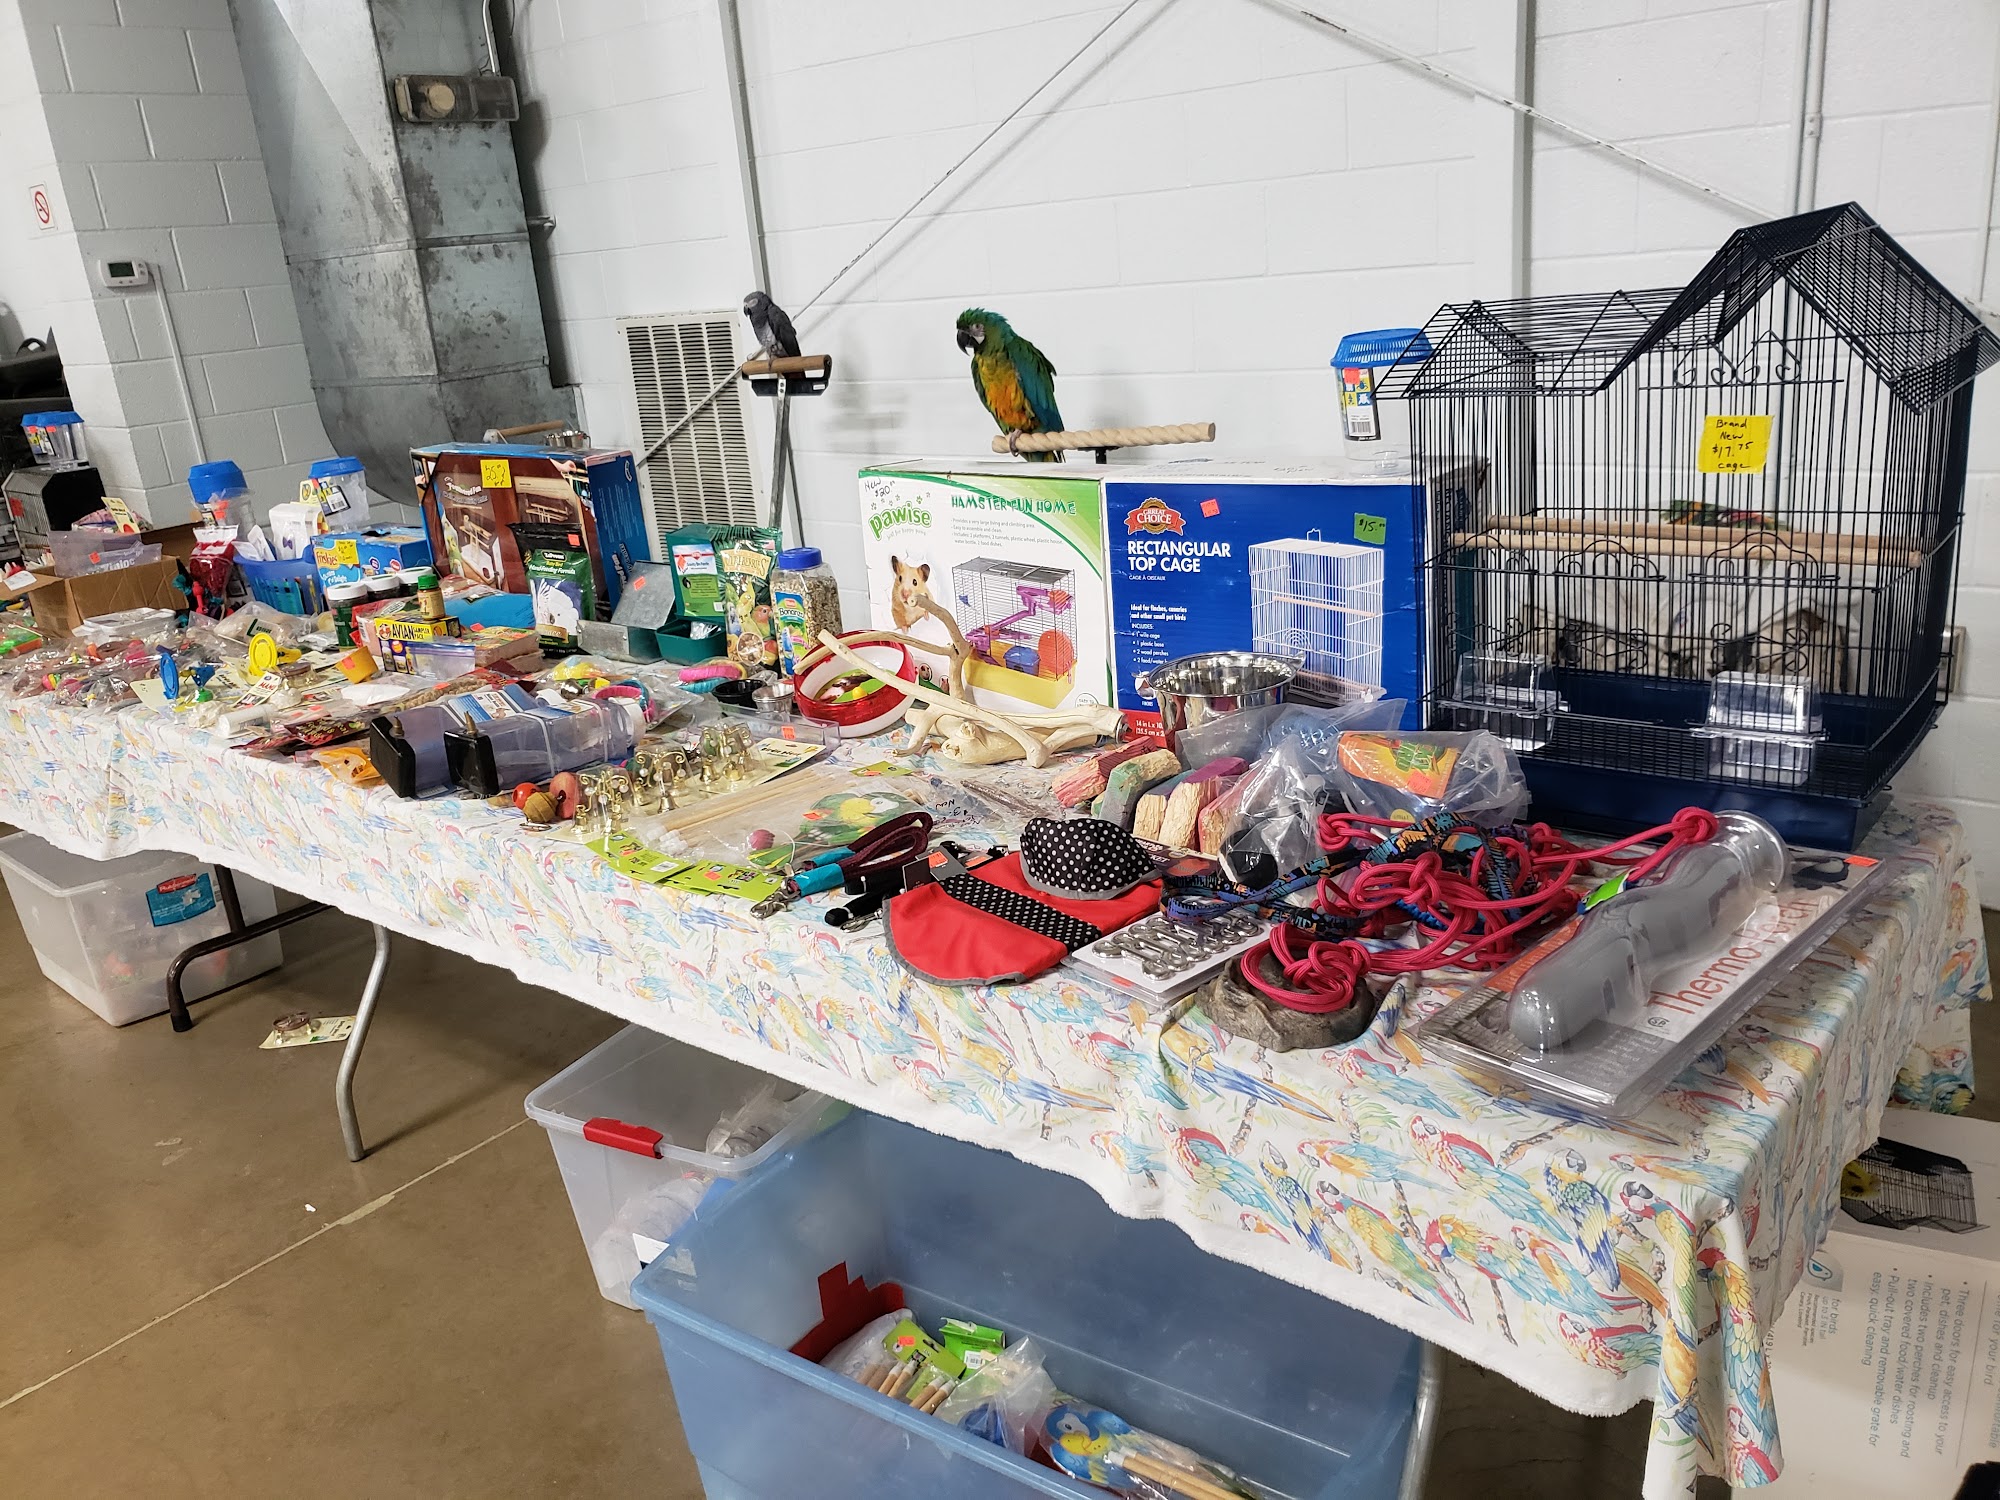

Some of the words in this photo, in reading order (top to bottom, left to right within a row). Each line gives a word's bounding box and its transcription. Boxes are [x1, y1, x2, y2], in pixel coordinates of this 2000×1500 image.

[1716, 418, 1747, 429] Brand
[1720, 431, 1744, 441] New
[1718, 463, 1751, 472] cage
[951, 494, 1008, 511] HAMSTER
[1011, 497, 1033, 513] FUN
[1036, 498, 1076, 515] HOME
[868, 501, 932, 541] pawise
[1137, 513, 1172, 524] CHOICE
[1128, 540, 1232, 558] RECTANGULAR
[1128, 556, 1157, 571] TOP
[1160, 557, 1201, 573] CAGE
[1150, 604, 1168, 612] finches,
[392, 623, 415, 640] AVIAN
[1885, 1275, 1900, 1313] Pull-out
[1906, 1278, 1918, 1298] two
[1831, 1298, 1841, 1311] for
[1867, 1297, 1880, 1324] quick
[1920, 1281, 1933, 1322] Includes
[1956, 1290, 1970, 1317] Three
[1828, 1312, 1839, 1334] birds
[1880, 1315, 1893, 1334] tray
[1901, 1300, 1914, 1339] covered
[1936, 1310, 1950, 1340] dishes
[1916, 1324, 1927, 1343] two
[1951, 1319, 1964, 1347] doors
[1861, 1326, 1877, 1366] cleaning
[1880, 1336, 1890, 1355] and
[1933, 1343, 1943, 1361] and
[1949, 1350, 1961, 1363] for
[1988, 1337, 1999, 1361] your
[1894, 1341, 1912, 1394] food/water
[1911, 1344, 1924, 1382] perches
[1874, 1356, 1887, 1405] removable
[1927, 1363, 1942, 1400] cleanup
[1943, 1365, 1956, 1387] easy
[1983, 1364, 1995, 1386] bird
[1909, 1384, 1920, 1399] for
[1889, 1395, 1903, 1425] dishes
[1940, 1389, 1952, 1420] access
[1870, 1407, 1881, 1431] grate
[1901, 1400, 1916, 1438] roosting
[1938, 1422, 1948, 1432] to
[1868, 1434, 1880, 1447] for
[1900, 1439, 1911, 1458] and
[1934, 1433, 1945, 1455] your
